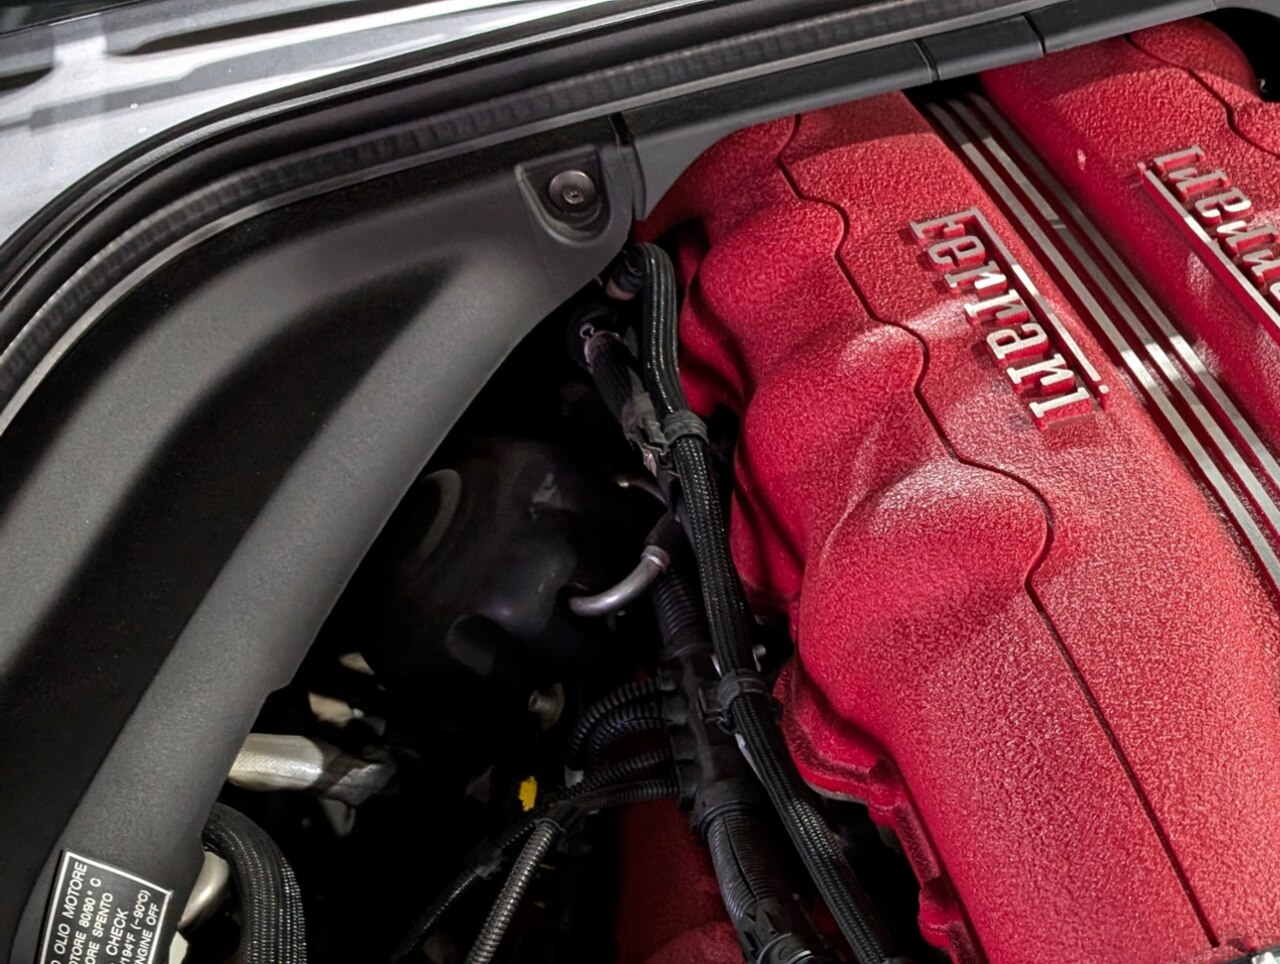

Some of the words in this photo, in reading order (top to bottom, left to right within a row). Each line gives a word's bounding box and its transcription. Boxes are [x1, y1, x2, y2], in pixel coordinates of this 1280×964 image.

[910, 207, 1109, 426] Ferrari
[54, 923, 70, 955] OLIO
[62, 861, 87, 919] MOTORE
[92, 892, 113, 937] SPENTO
[105, 908, 129, 956] CHECK
[146, 902, 160, 926] OFF
